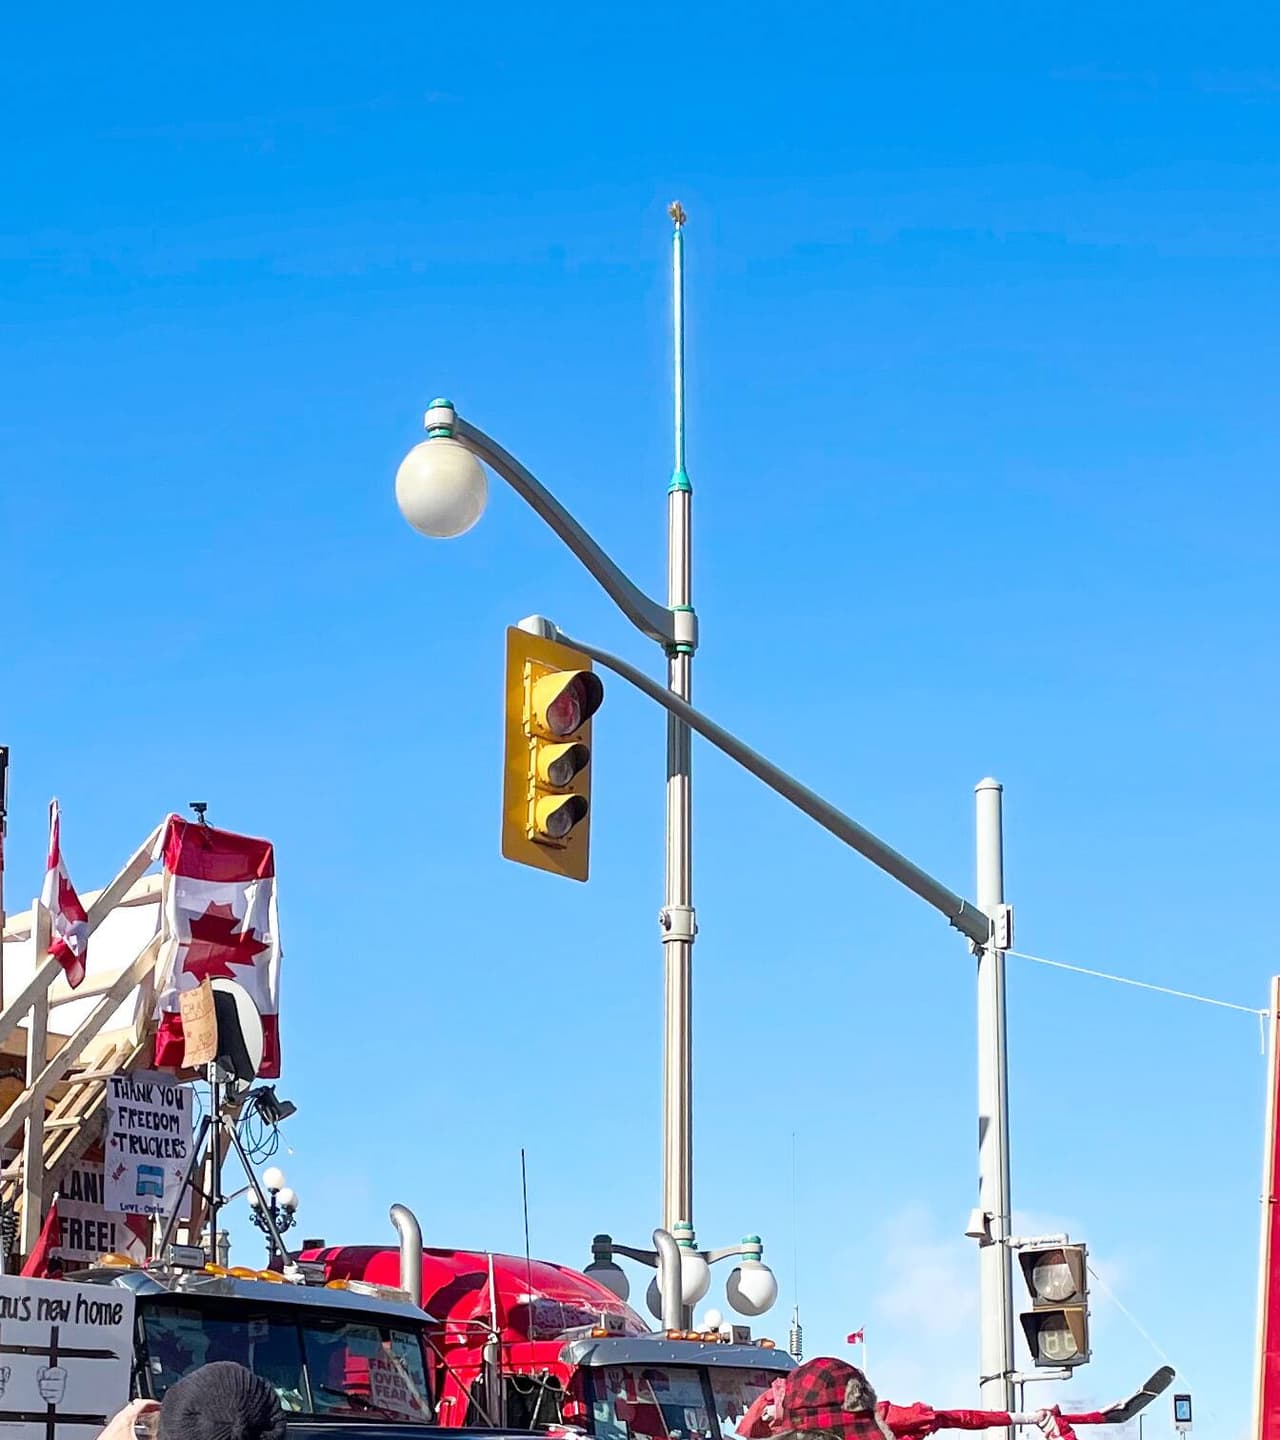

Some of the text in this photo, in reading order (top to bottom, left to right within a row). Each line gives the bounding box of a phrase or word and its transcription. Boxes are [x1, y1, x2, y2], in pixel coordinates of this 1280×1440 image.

[110, 1077, 185, 1110] THANK YOU
[117, 1106, 180, 1134] FREEDOM
[113, 1132, 188, 1159] TRUCKERS
[37, 1296, 71, 1322] new
[75, 1293, 123, 1326] home
